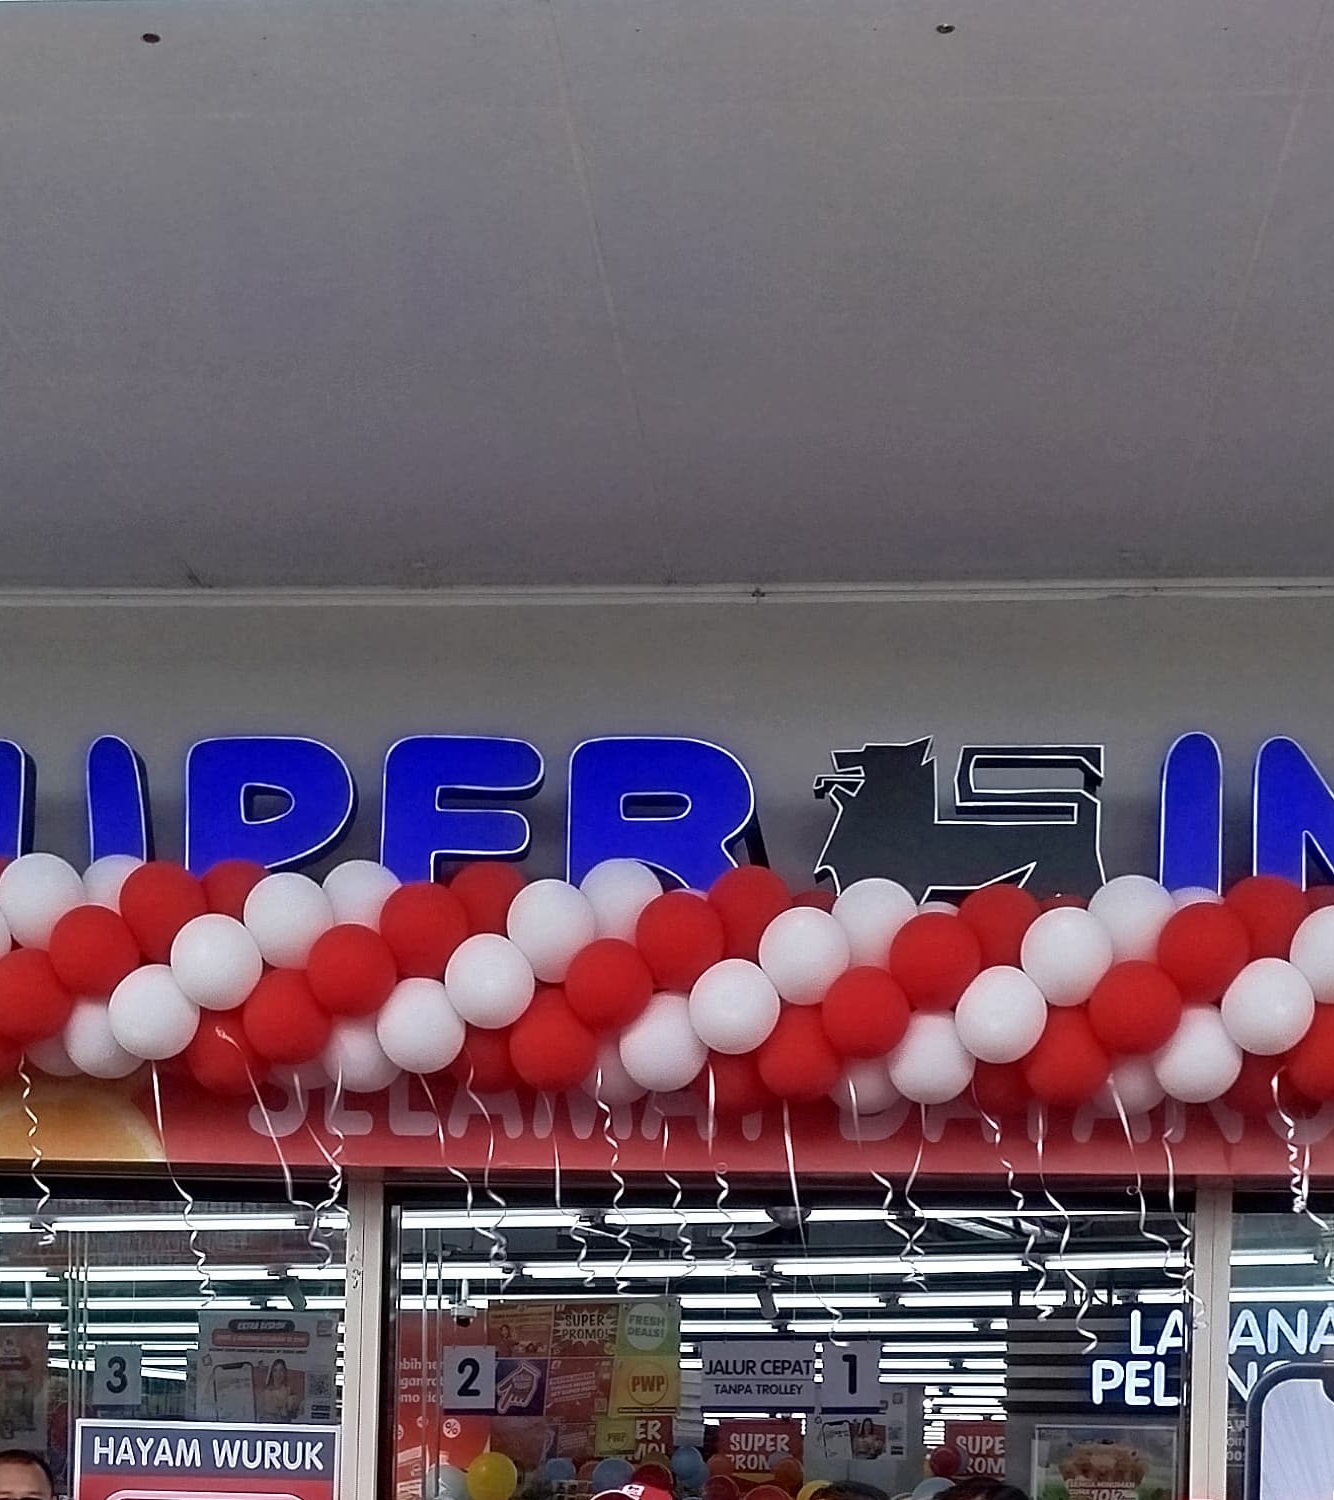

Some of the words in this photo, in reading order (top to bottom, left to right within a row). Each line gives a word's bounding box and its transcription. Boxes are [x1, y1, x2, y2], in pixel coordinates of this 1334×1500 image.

[564, 1311, 605, 1327] SUPER
[627, 1314, 666, 1326] FRESH
[561, 1327, 609, 1341] PROMO!
[626, 1326, 666, 1338] DEALS!
[106, 1356, 128, 1393] 3
[457, 1357, 481, 1397] 2
[705, 1359, 757, 1376] JALUR
[763, 1359, 814, 1376] CEPAT
[842, 1353, 858, 1395] 1
[631, 1374, 666, 1393] PWP
[714, 1383, 753, 1396] TANPA
[756, 1383, 804, 1396] TROLLEY
[729, 1433, 790, 1452] SUPER
[955, 1435, 1005, 1455] SUPE
[93, 1436, 202, 1468] HAYAM
[212, 1439, 324, 1471] WURUK
